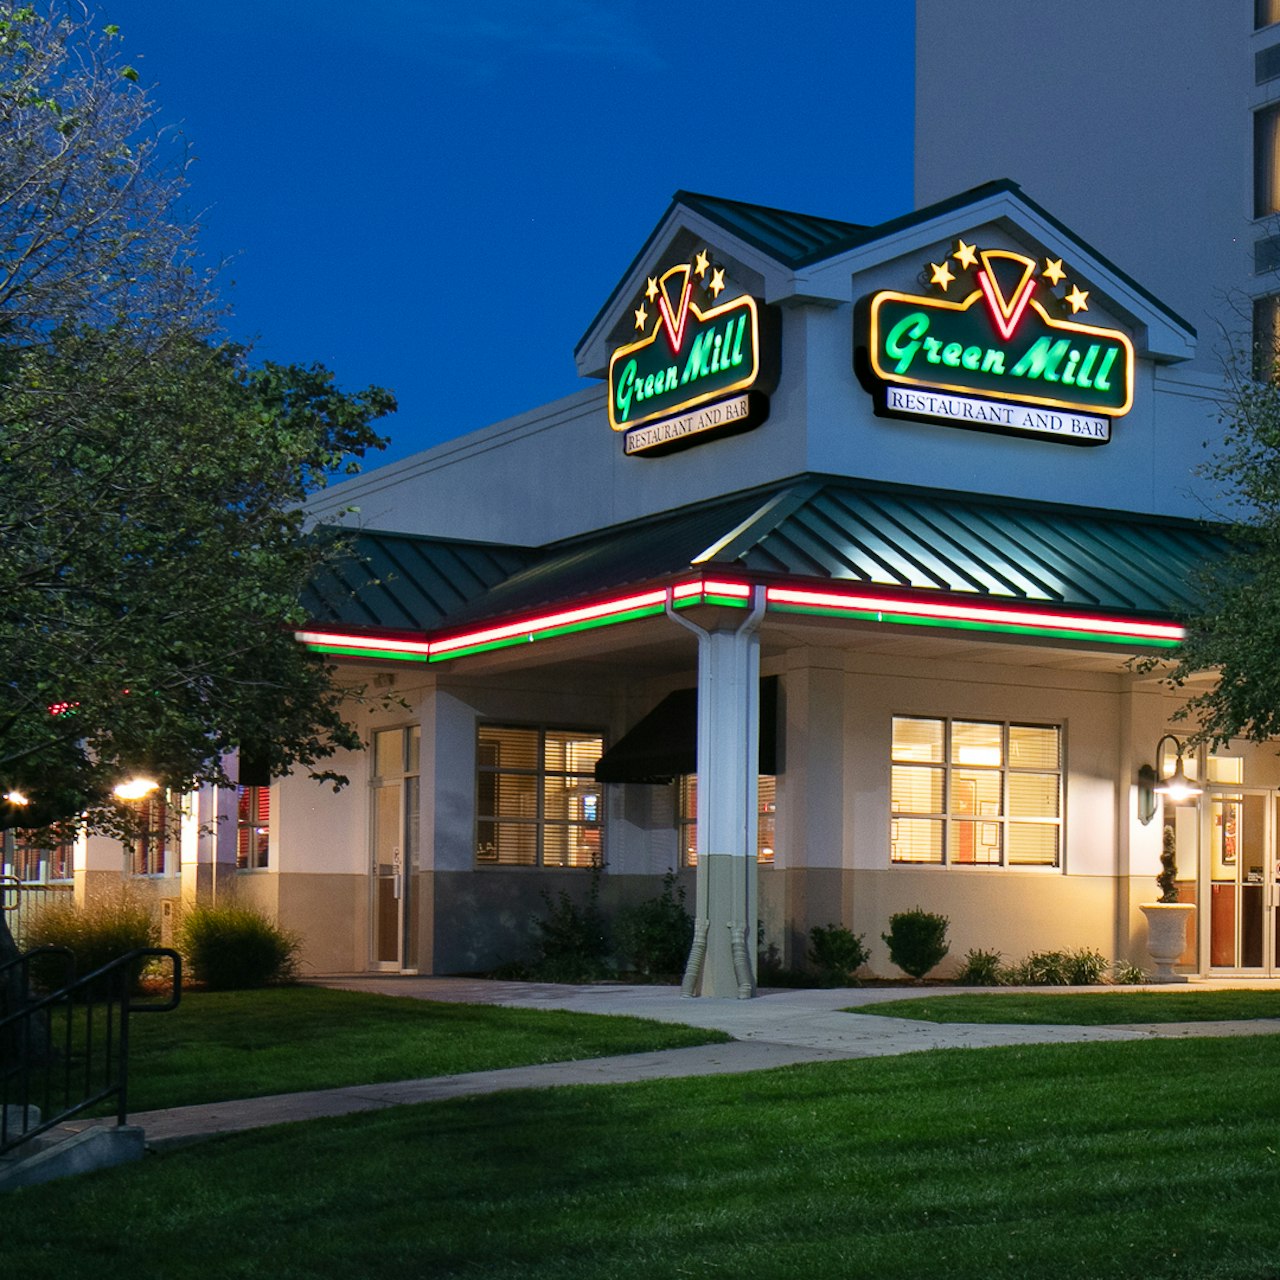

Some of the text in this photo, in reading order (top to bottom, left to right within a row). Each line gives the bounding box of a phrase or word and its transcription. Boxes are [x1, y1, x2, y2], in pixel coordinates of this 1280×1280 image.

[616, 313, 747, 422] Green Mill
[885, 311, 1119, 392] Green Mill
[628, 400, 748, 451] RESTAURANT AND BAR
[891, 391, 1106, 438] RESTAURANT AND BAR
